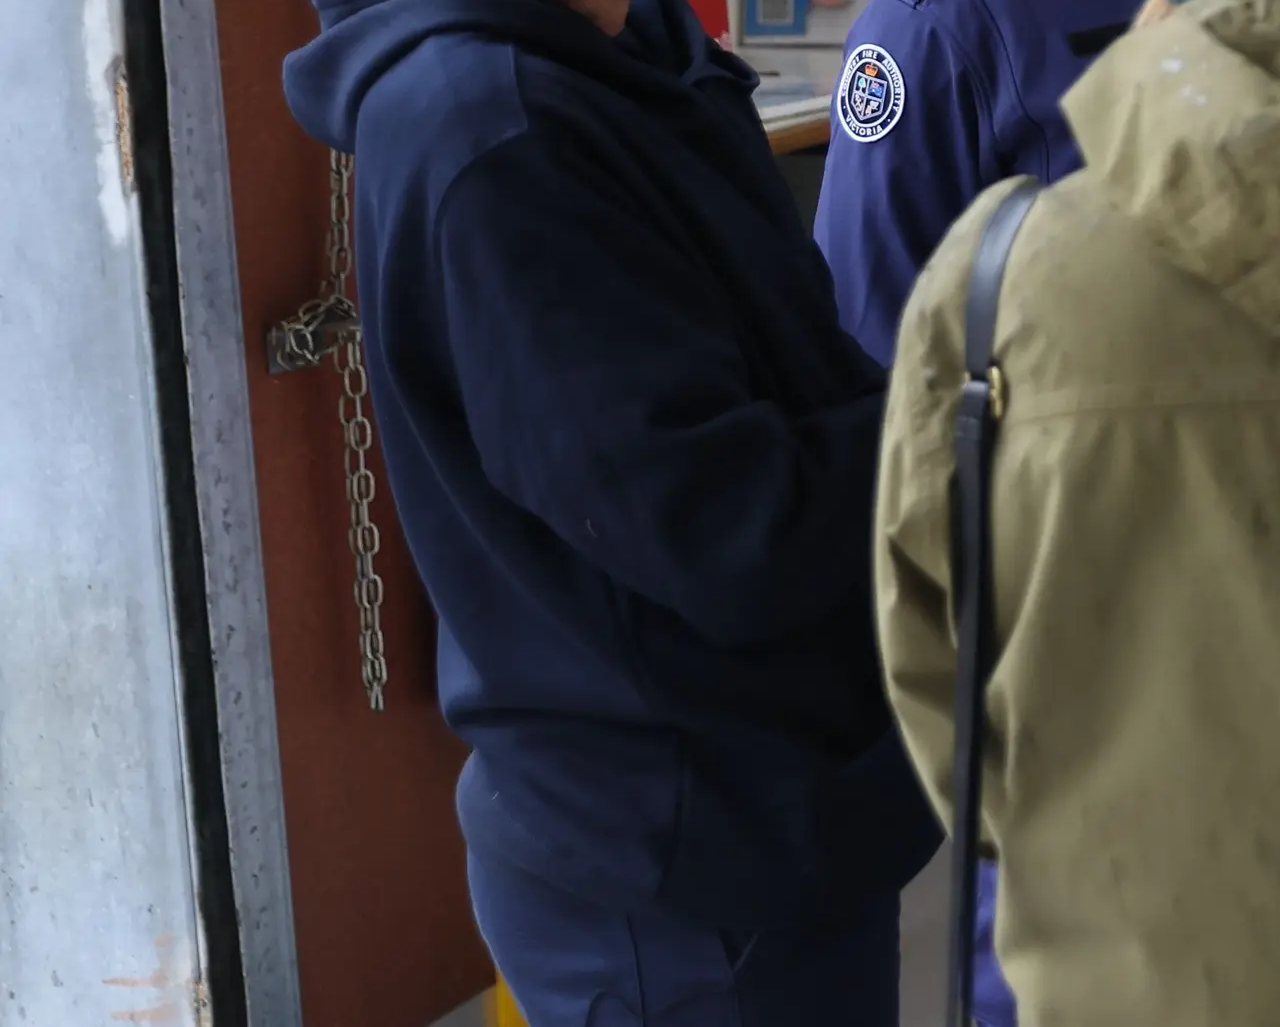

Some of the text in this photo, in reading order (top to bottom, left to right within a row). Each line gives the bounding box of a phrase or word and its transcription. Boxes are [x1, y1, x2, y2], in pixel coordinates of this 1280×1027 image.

[862, 49, 878, 60] FIRE
[881, 58, 902, 113] AUTHORITY
[845, 113, 884, 136] VICTORIA
